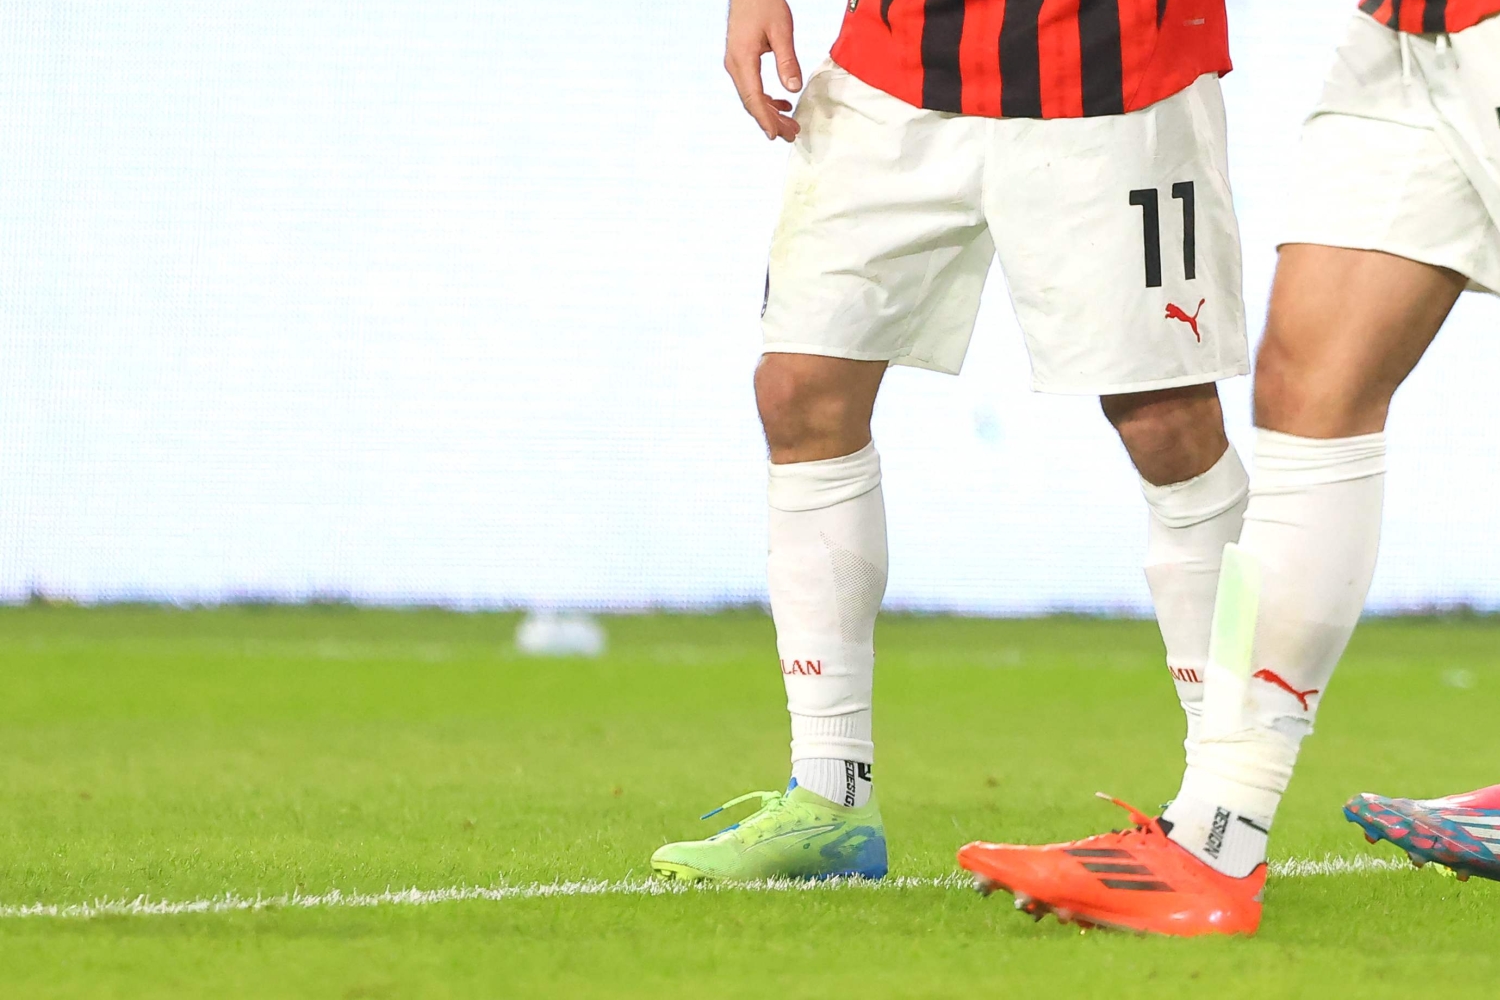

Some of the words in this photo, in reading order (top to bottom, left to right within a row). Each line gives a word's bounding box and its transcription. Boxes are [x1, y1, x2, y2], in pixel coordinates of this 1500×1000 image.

[1129, 181, 1195, 288] 11
[779, 659, 821, 675] LAN
[1169, 665, 1203, 682] MIL
